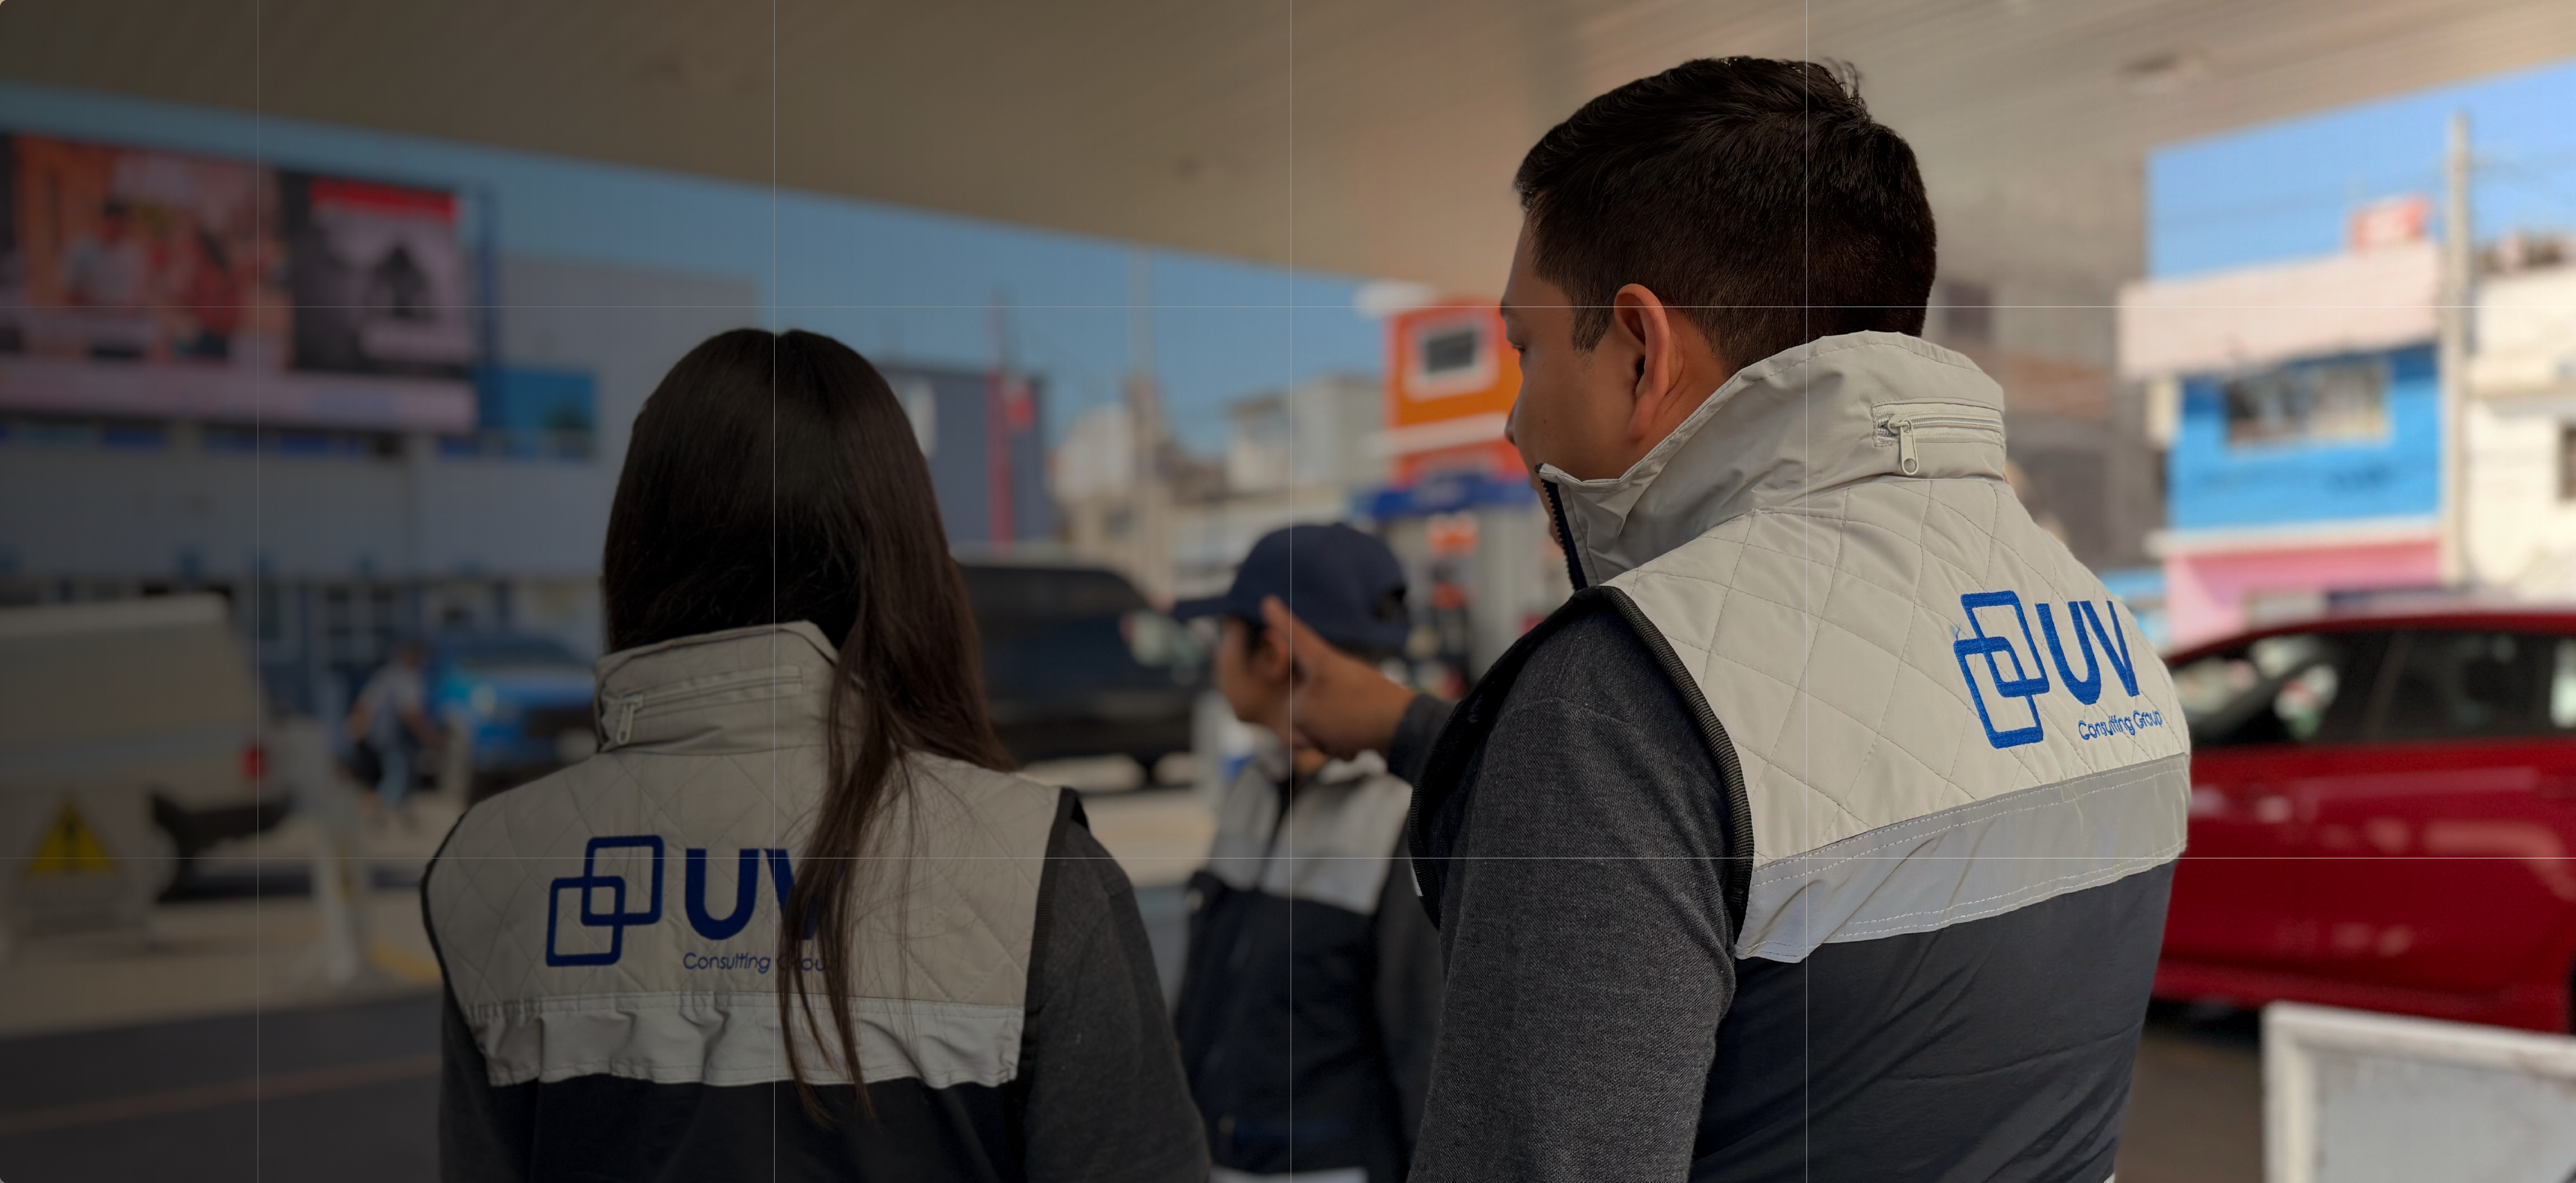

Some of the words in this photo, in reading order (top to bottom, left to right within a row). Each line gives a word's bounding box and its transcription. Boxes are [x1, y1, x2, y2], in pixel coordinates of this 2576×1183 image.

[2035, 601, 2139, 705] UV
[2078, 715, 2136, 740] Consulting
[2132, 710, 2163, 729] Group
[683, 952, 771, 974] Consulting
